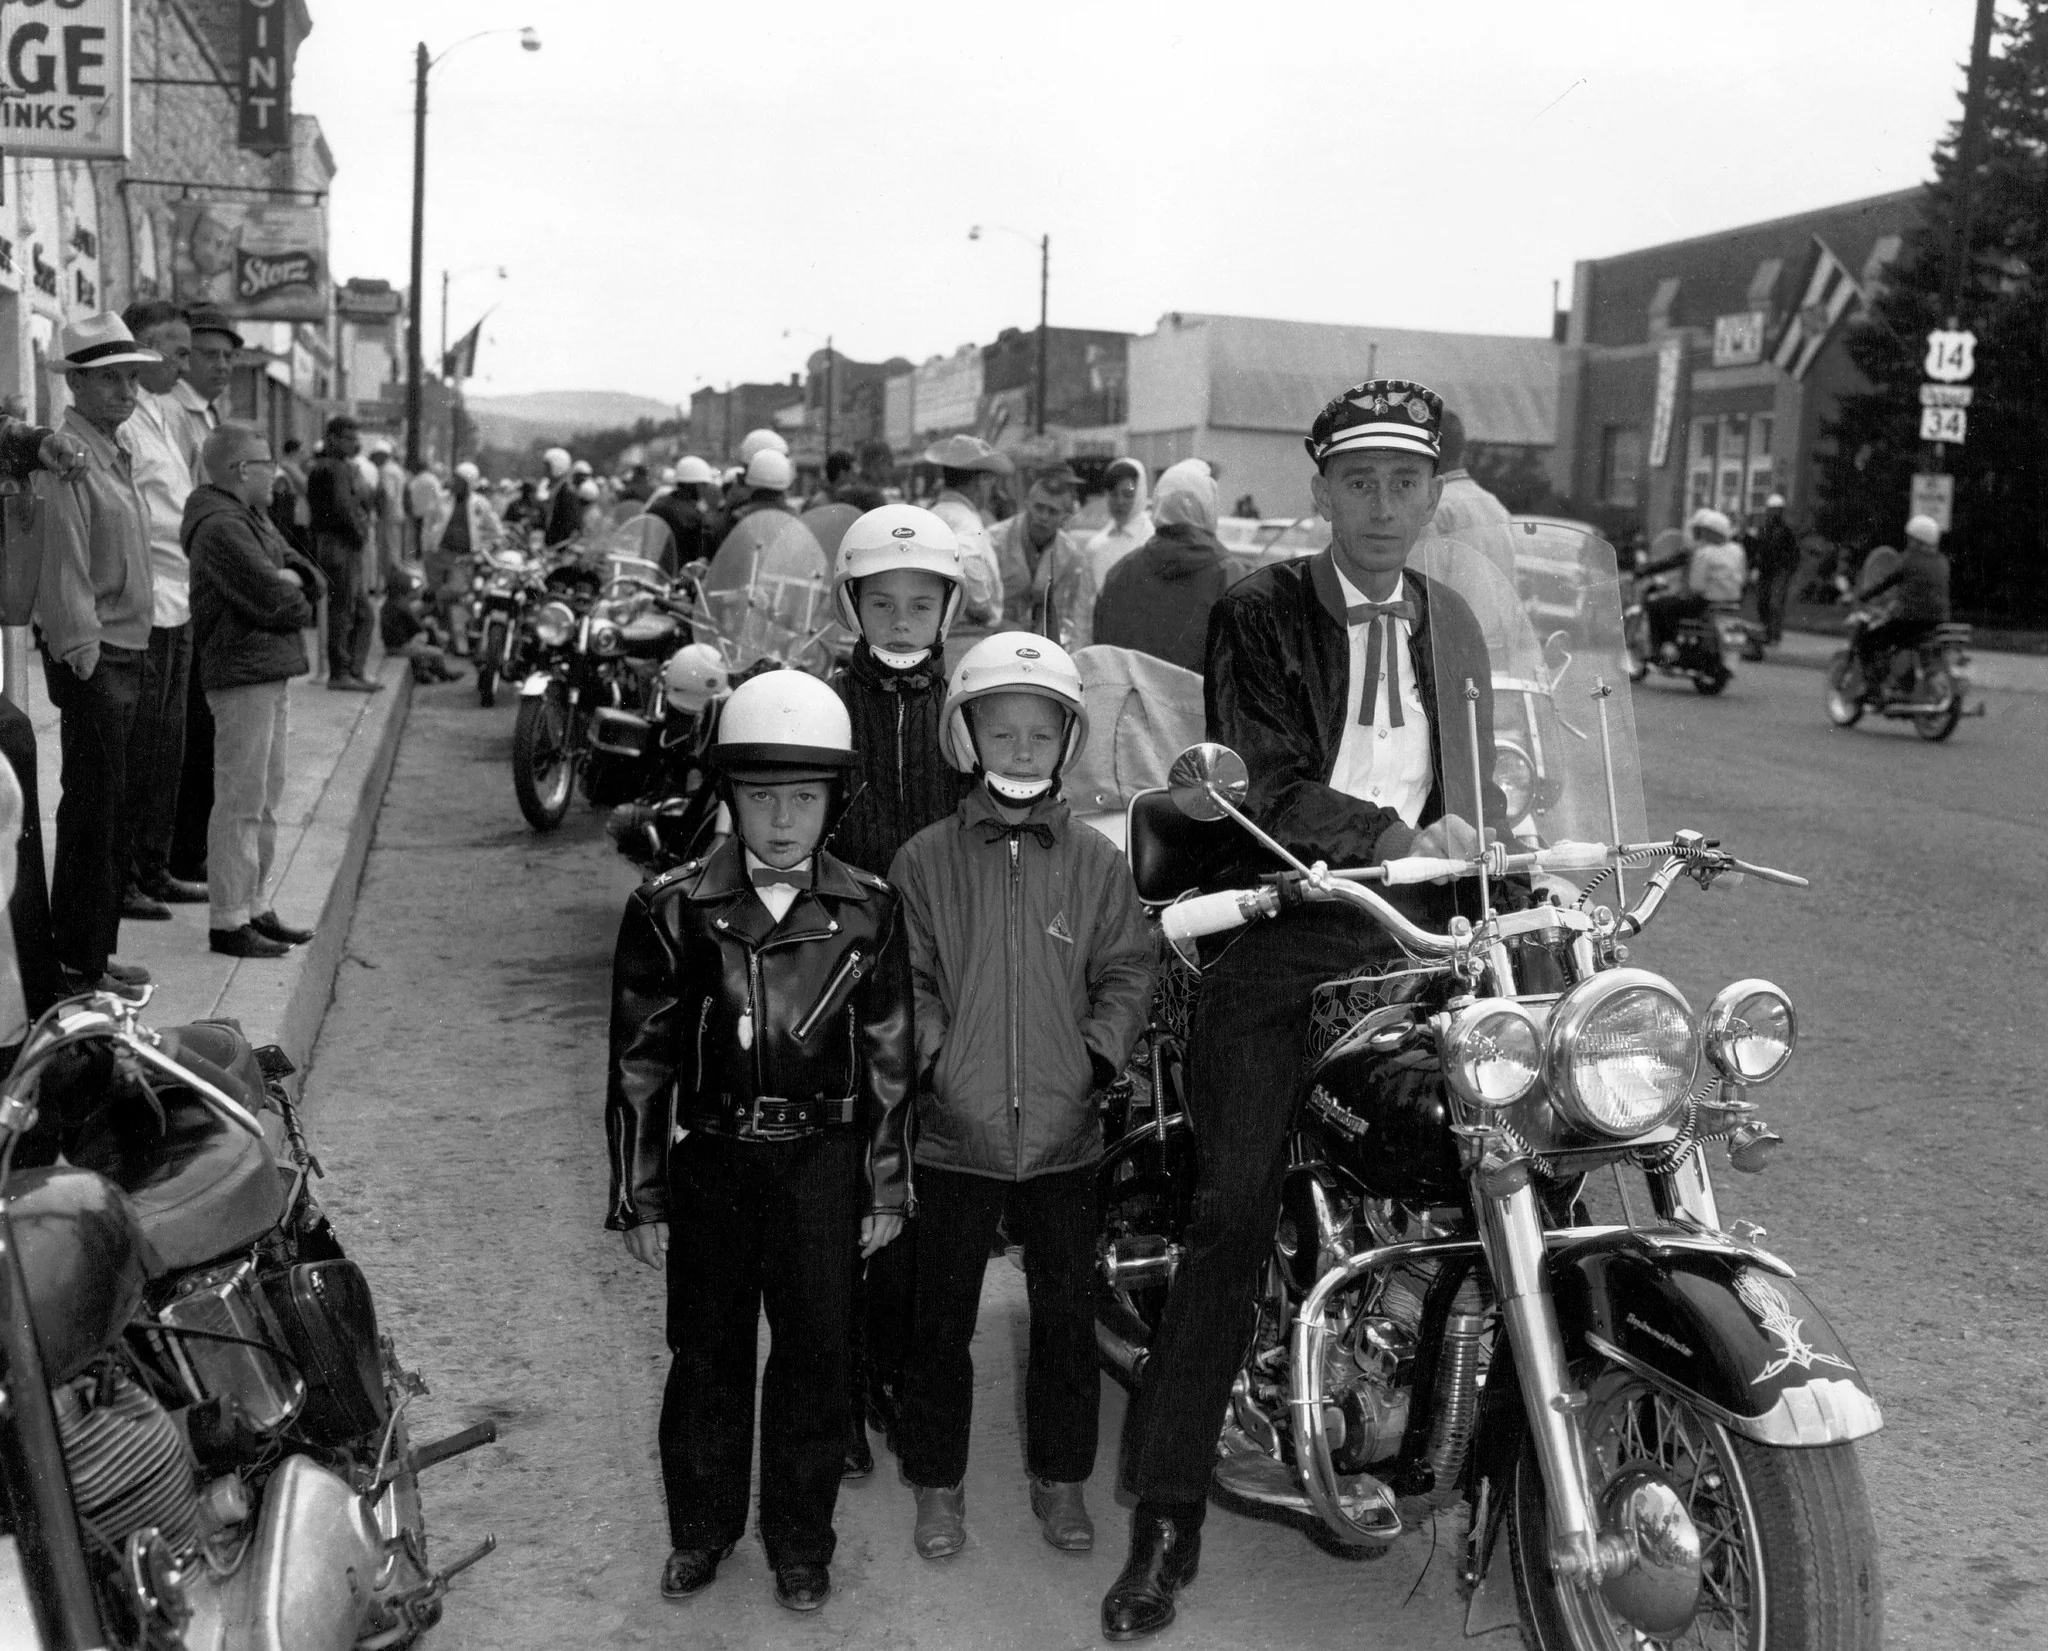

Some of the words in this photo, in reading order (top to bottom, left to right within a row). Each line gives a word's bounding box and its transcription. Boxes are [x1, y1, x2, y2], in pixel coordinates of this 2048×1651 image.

[248, 0, 277, 129] INT
[1938, 341, 1963, 370] 14
[1928, 410, 1959, 436] 34
